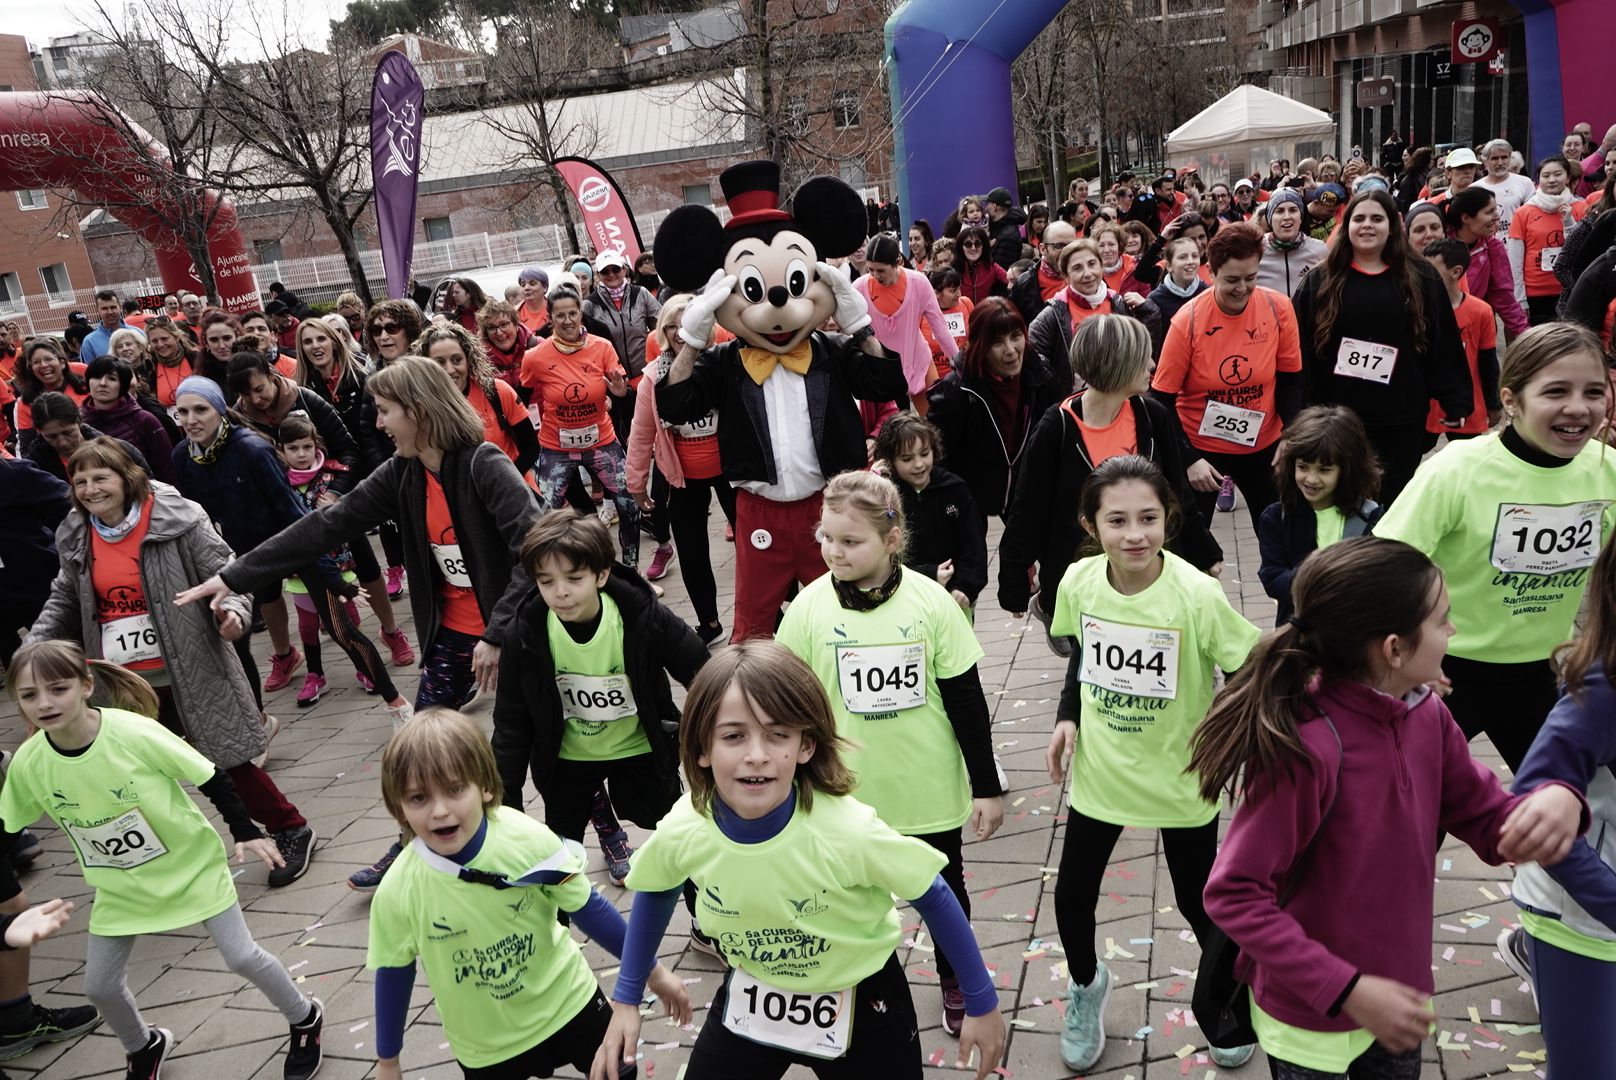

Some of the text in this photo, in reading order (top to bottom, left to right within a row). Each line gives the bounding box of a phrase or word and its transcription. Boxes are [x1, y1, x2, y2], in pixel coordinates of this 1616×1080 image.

[0, 133, 50, 148] nresa
[220, 268, 232, 277] de
[1348, 351, 1383, 370] 817
[566, 410, 577, 418] LA
[1213, 415, 1249, 434] 253
[569, 434, 592, 444] 115
[1512, 519, 1593, 555] 1032
[1503, 593, 1564, 605] santasusana
[1512, 606, 1547, 616] MANRESA
[116, 628, 158, 651] 176
[1091, 641, 1167, 677] 1044
[850, 663, 919, 692] 1045
[563, 688, 626, 709] 1068
[864, 712, 899, 721] MANRESA
[1097, 706, 1156, 722] santasusana
[1107, 721, 1143, 733] MANRESA
[745, 928, 804, 940] 5a CURSA
[485, 933, 520, 955] CURSA
[748, 938, 765, 948] DE
[767, 936, 783, 946] LA
[489, 952, 502, 963] LA
[743, 984, 838, 1029] 1056
